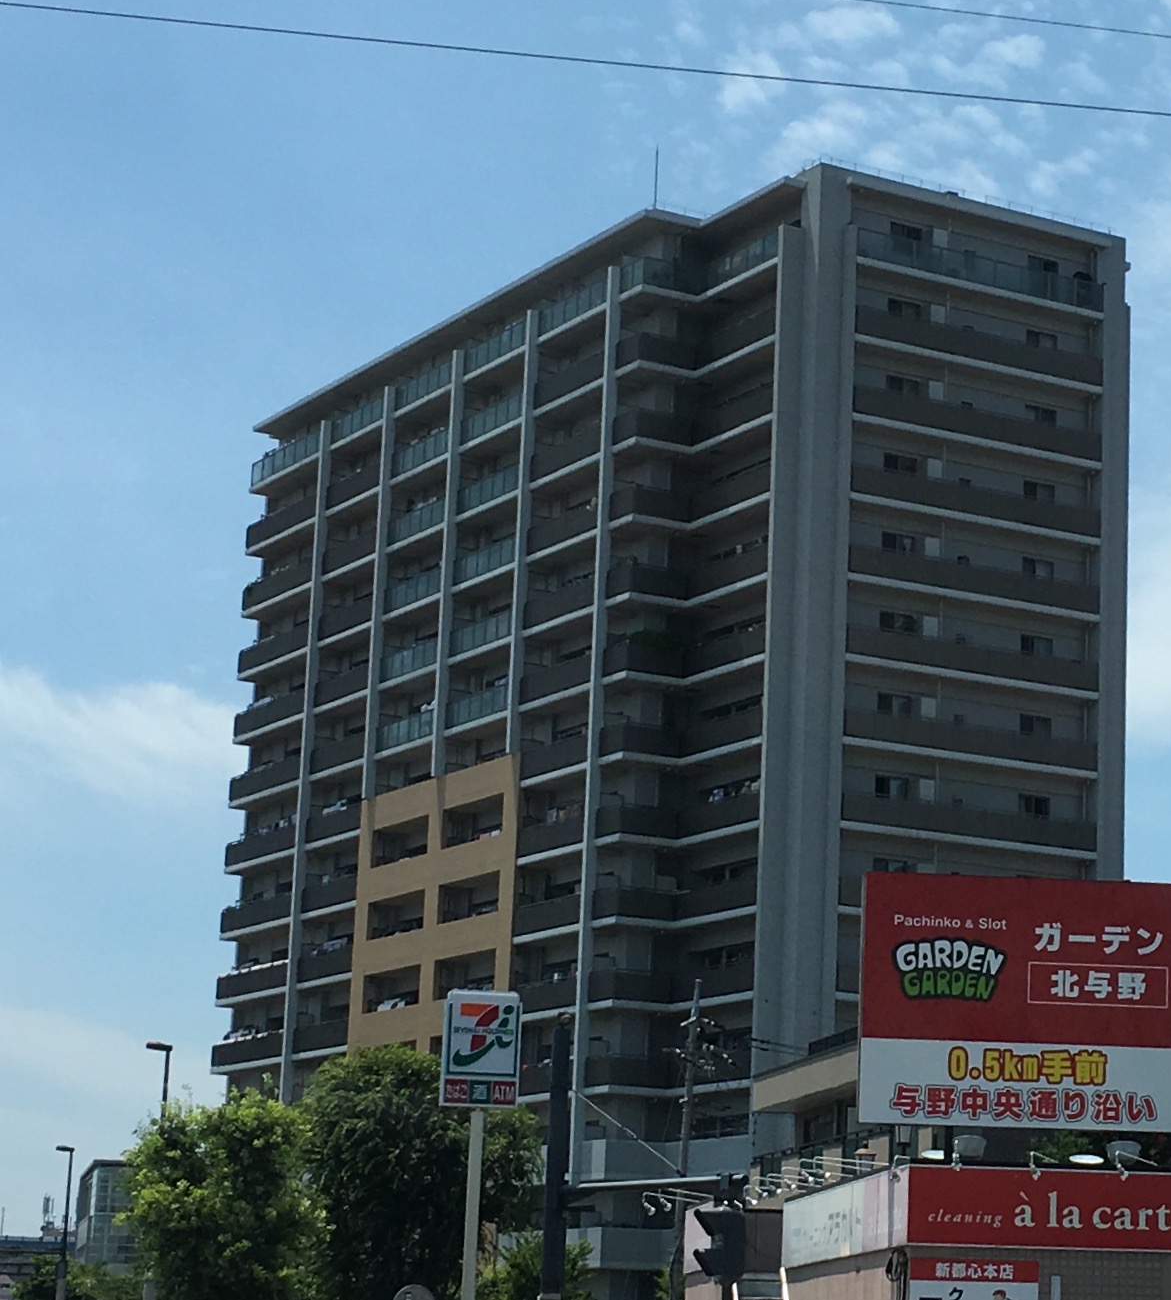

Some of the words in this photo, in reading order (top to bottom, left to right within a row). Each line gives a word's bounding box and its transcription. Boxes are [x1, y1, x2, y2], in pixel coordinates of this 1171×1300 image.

[893, 914, 961, 929] Pachinko
[965, 919, 974, 929] &
[978, 917, 1007, 931] Slot
[1034, 922, 1164, 956] ガーデン
[895, 939, 1004, 976] GARDEN
[903, 971, 996, 1000] GARDEN
[1050, 969, 1147, 1001] 北与野
[948, 1046, 1108, 1086] 0.5km手前
[493, 1085, 516, 1101] ATM
[889, 1084, 1158, 1124] 与野中央通り沿い
[928, 1207, 1003, 1228] cleaning
[1014, 1191, 1035, 1227] à
[1046, 1191, 1083, 1229] la
[935, 1262, 1015, 1280] 新都心本店
